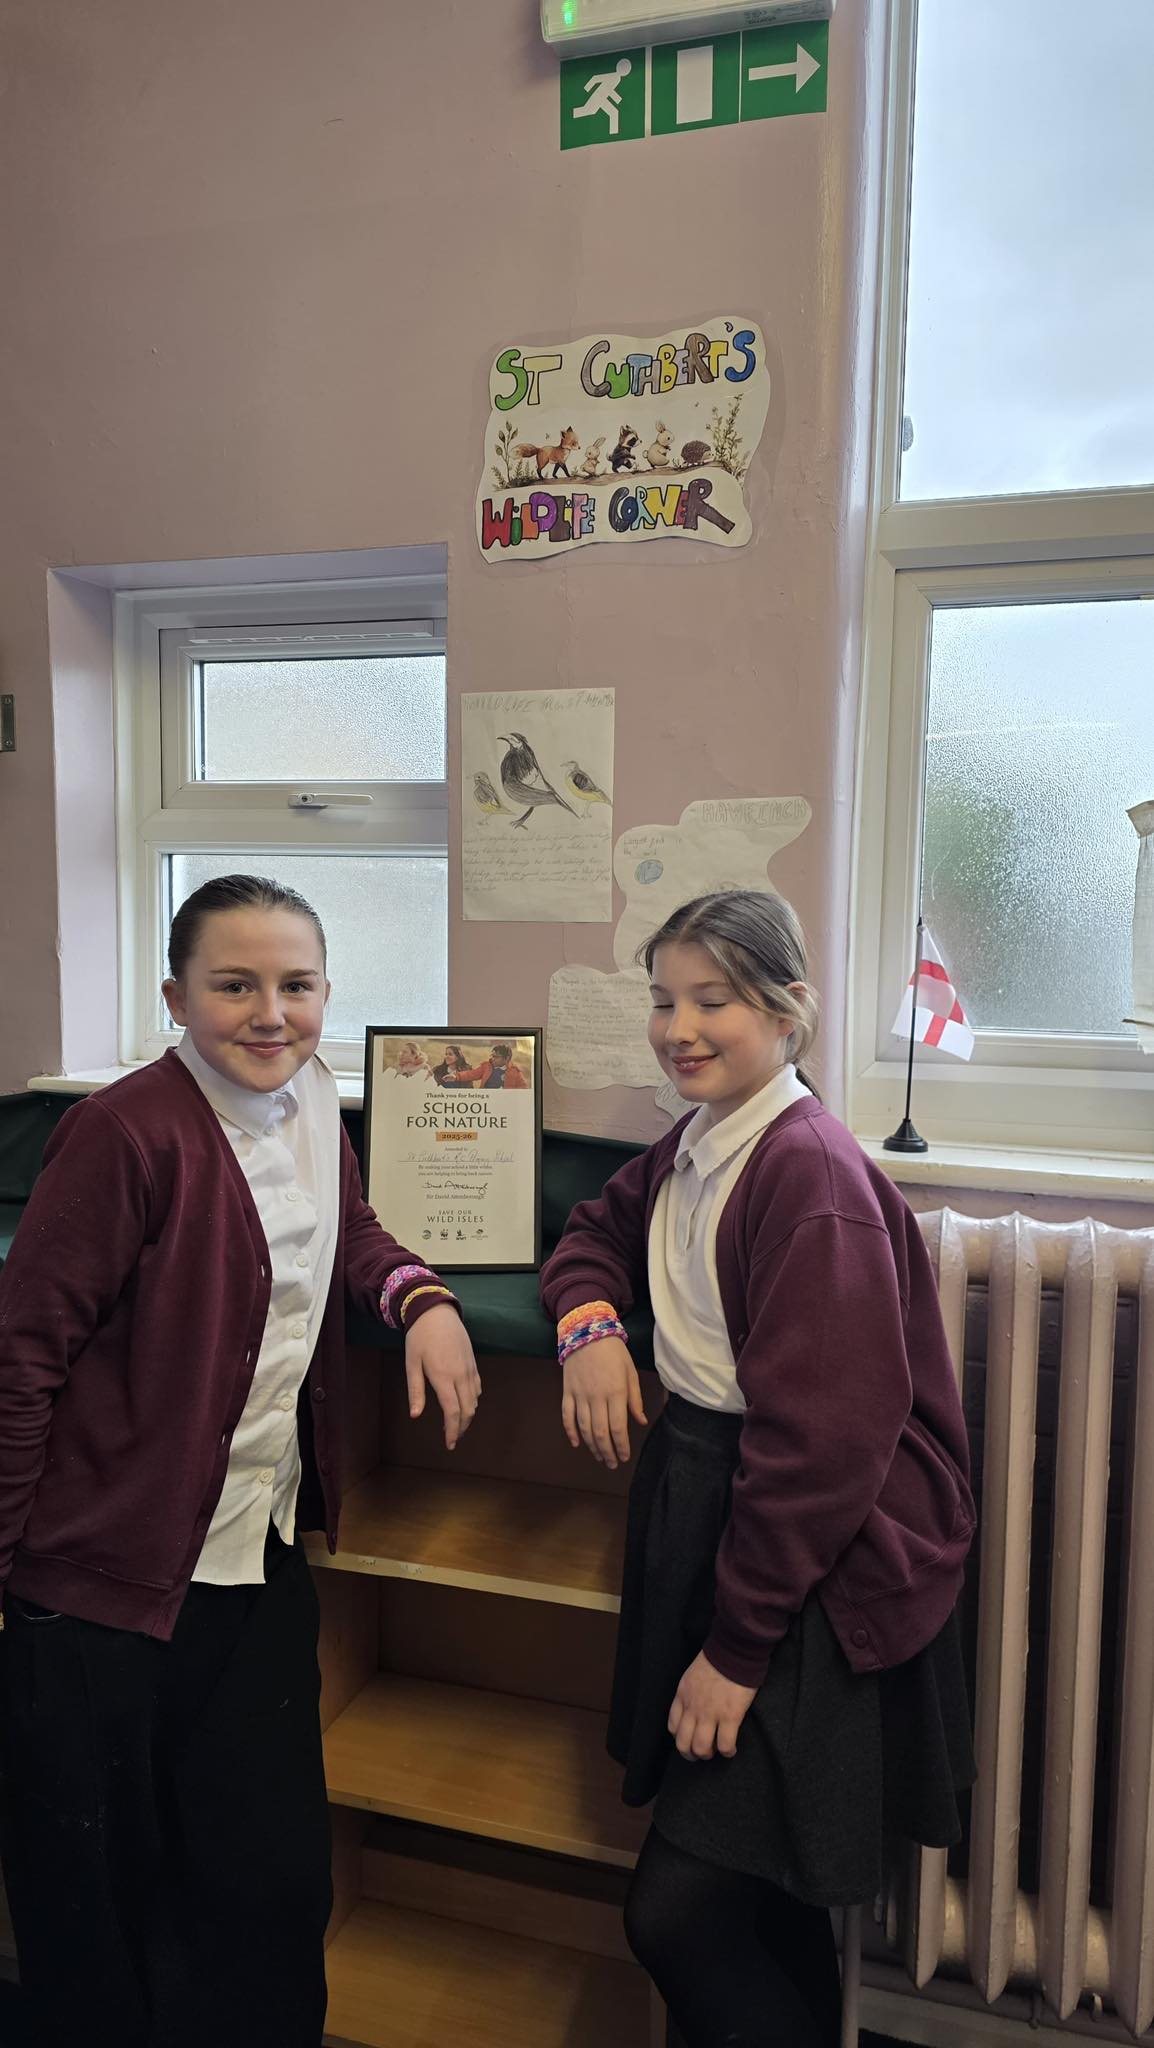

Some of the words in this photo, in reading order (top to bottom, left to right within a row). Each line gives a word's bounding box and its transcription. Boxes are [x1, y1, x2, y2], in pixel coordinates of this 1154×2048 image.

[495, 349, 562, 411] ST
[608, 478, 736, 534] CORNER
[407, 1116, 439, 1128] FOR
[444, 1116, 507, 1128] NATURE
[423, 1102, 491, 1114] SCHOOL
